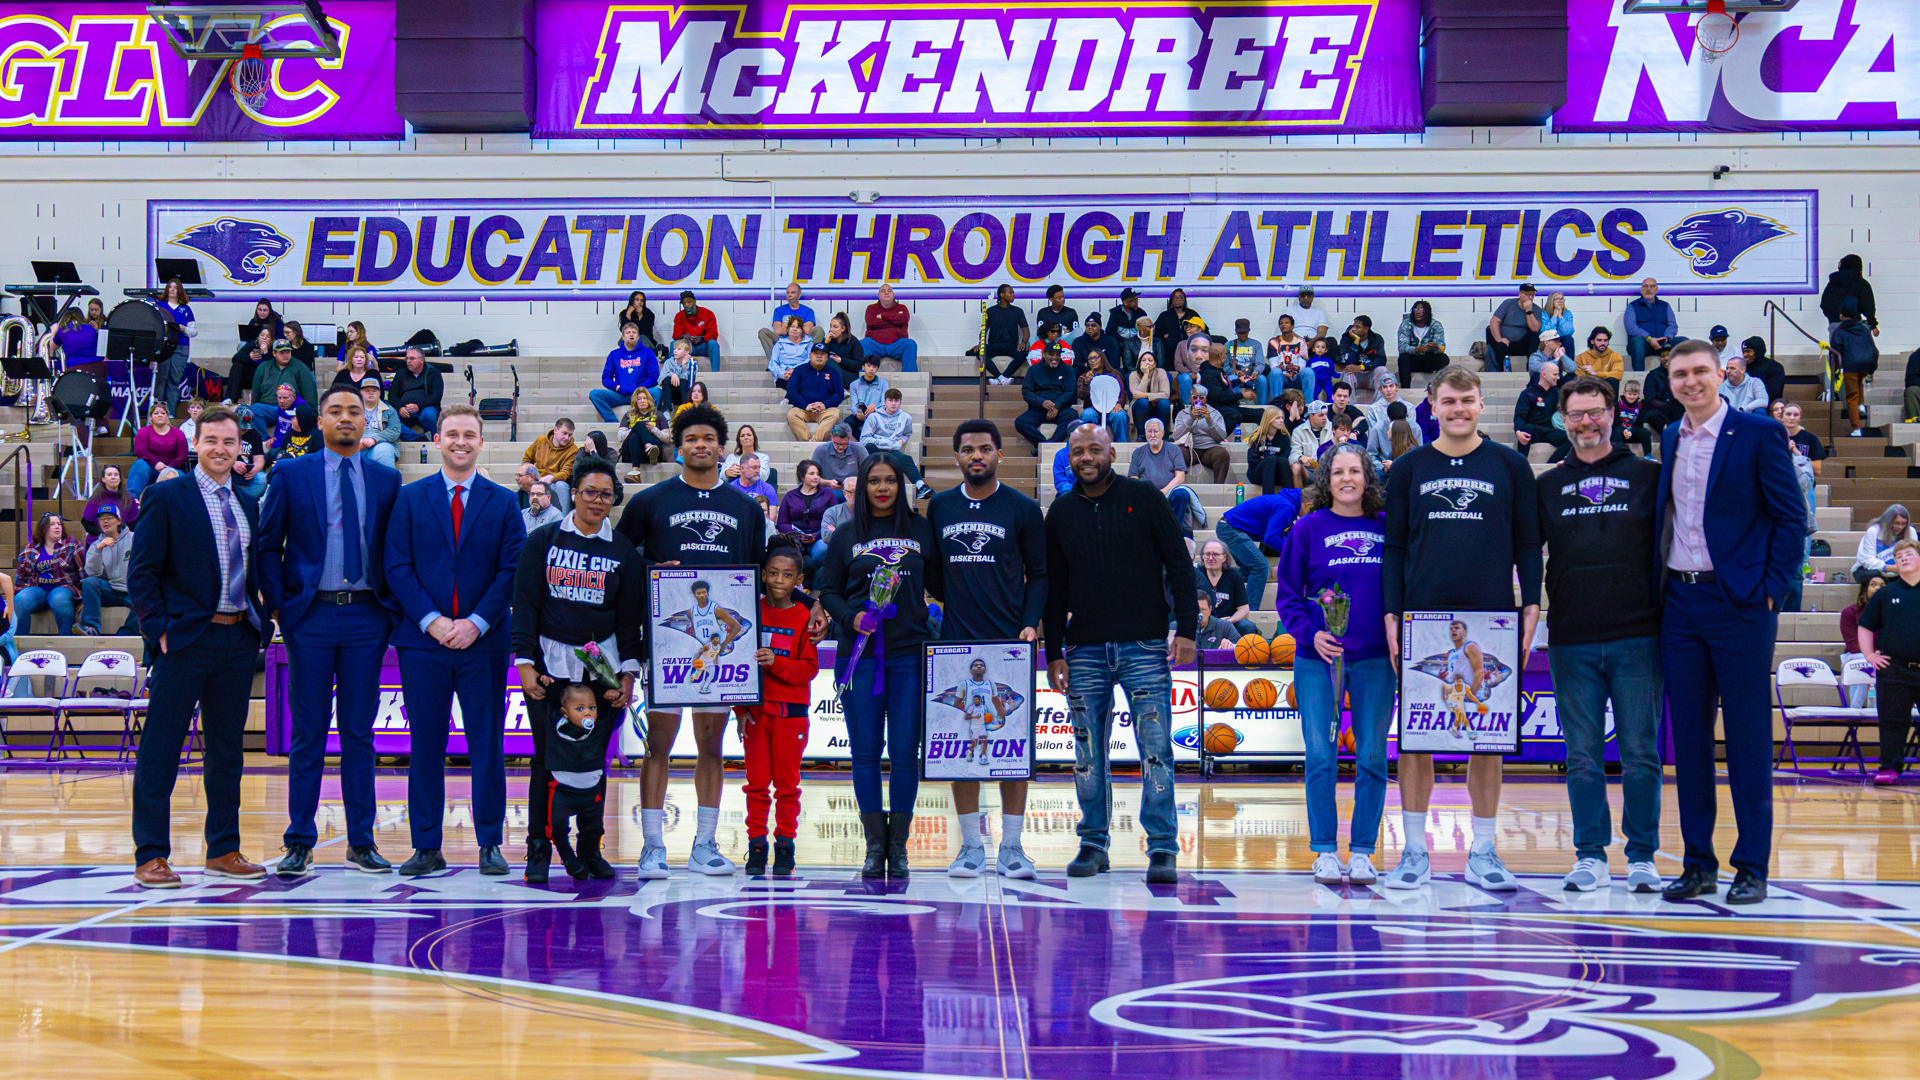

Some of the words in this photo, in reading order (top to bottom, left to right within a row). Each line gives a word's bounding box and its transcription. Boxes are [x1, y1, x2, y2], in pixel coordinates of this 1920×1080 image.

[0, 14, 350, 127] GLVC
[595, 14, 1358, 116] McKENDREE
[302, 213, 762, 286] EDUCATION
[783, 210, 1185, 284] THROUGH
[1199, 207, 1649, 281] ATHLETICS
[1420, 477, 1494, 496] McKENDREE
[1428, 511, 1483, 520] BASKETBALL
[1562, 504, 1628, 516] BASKETBALL
[669, 510, 738, 530] McKENDREE
[942, 522, 1005, 539] McKENDREE
[681, 543, 729, 553] BASKETBALL
[547, 545, 588, 570] PIXIE
[590, 556, 620, 573] CUT
[950, 555, 995, 563] BASKETBALL
[546, 566, 606, 590] LIPSTICK
[702, 628, 709, 638] 12
[763, 626, 791, 635] OMMY
[1170, 688, 1196, 706] IA
[814, 700, 844, 714] Alls
[932, 732, 958, 740] CALEB
[1035, 741, 1063, 750] allon
[1066, 741, 1073, 749] &
